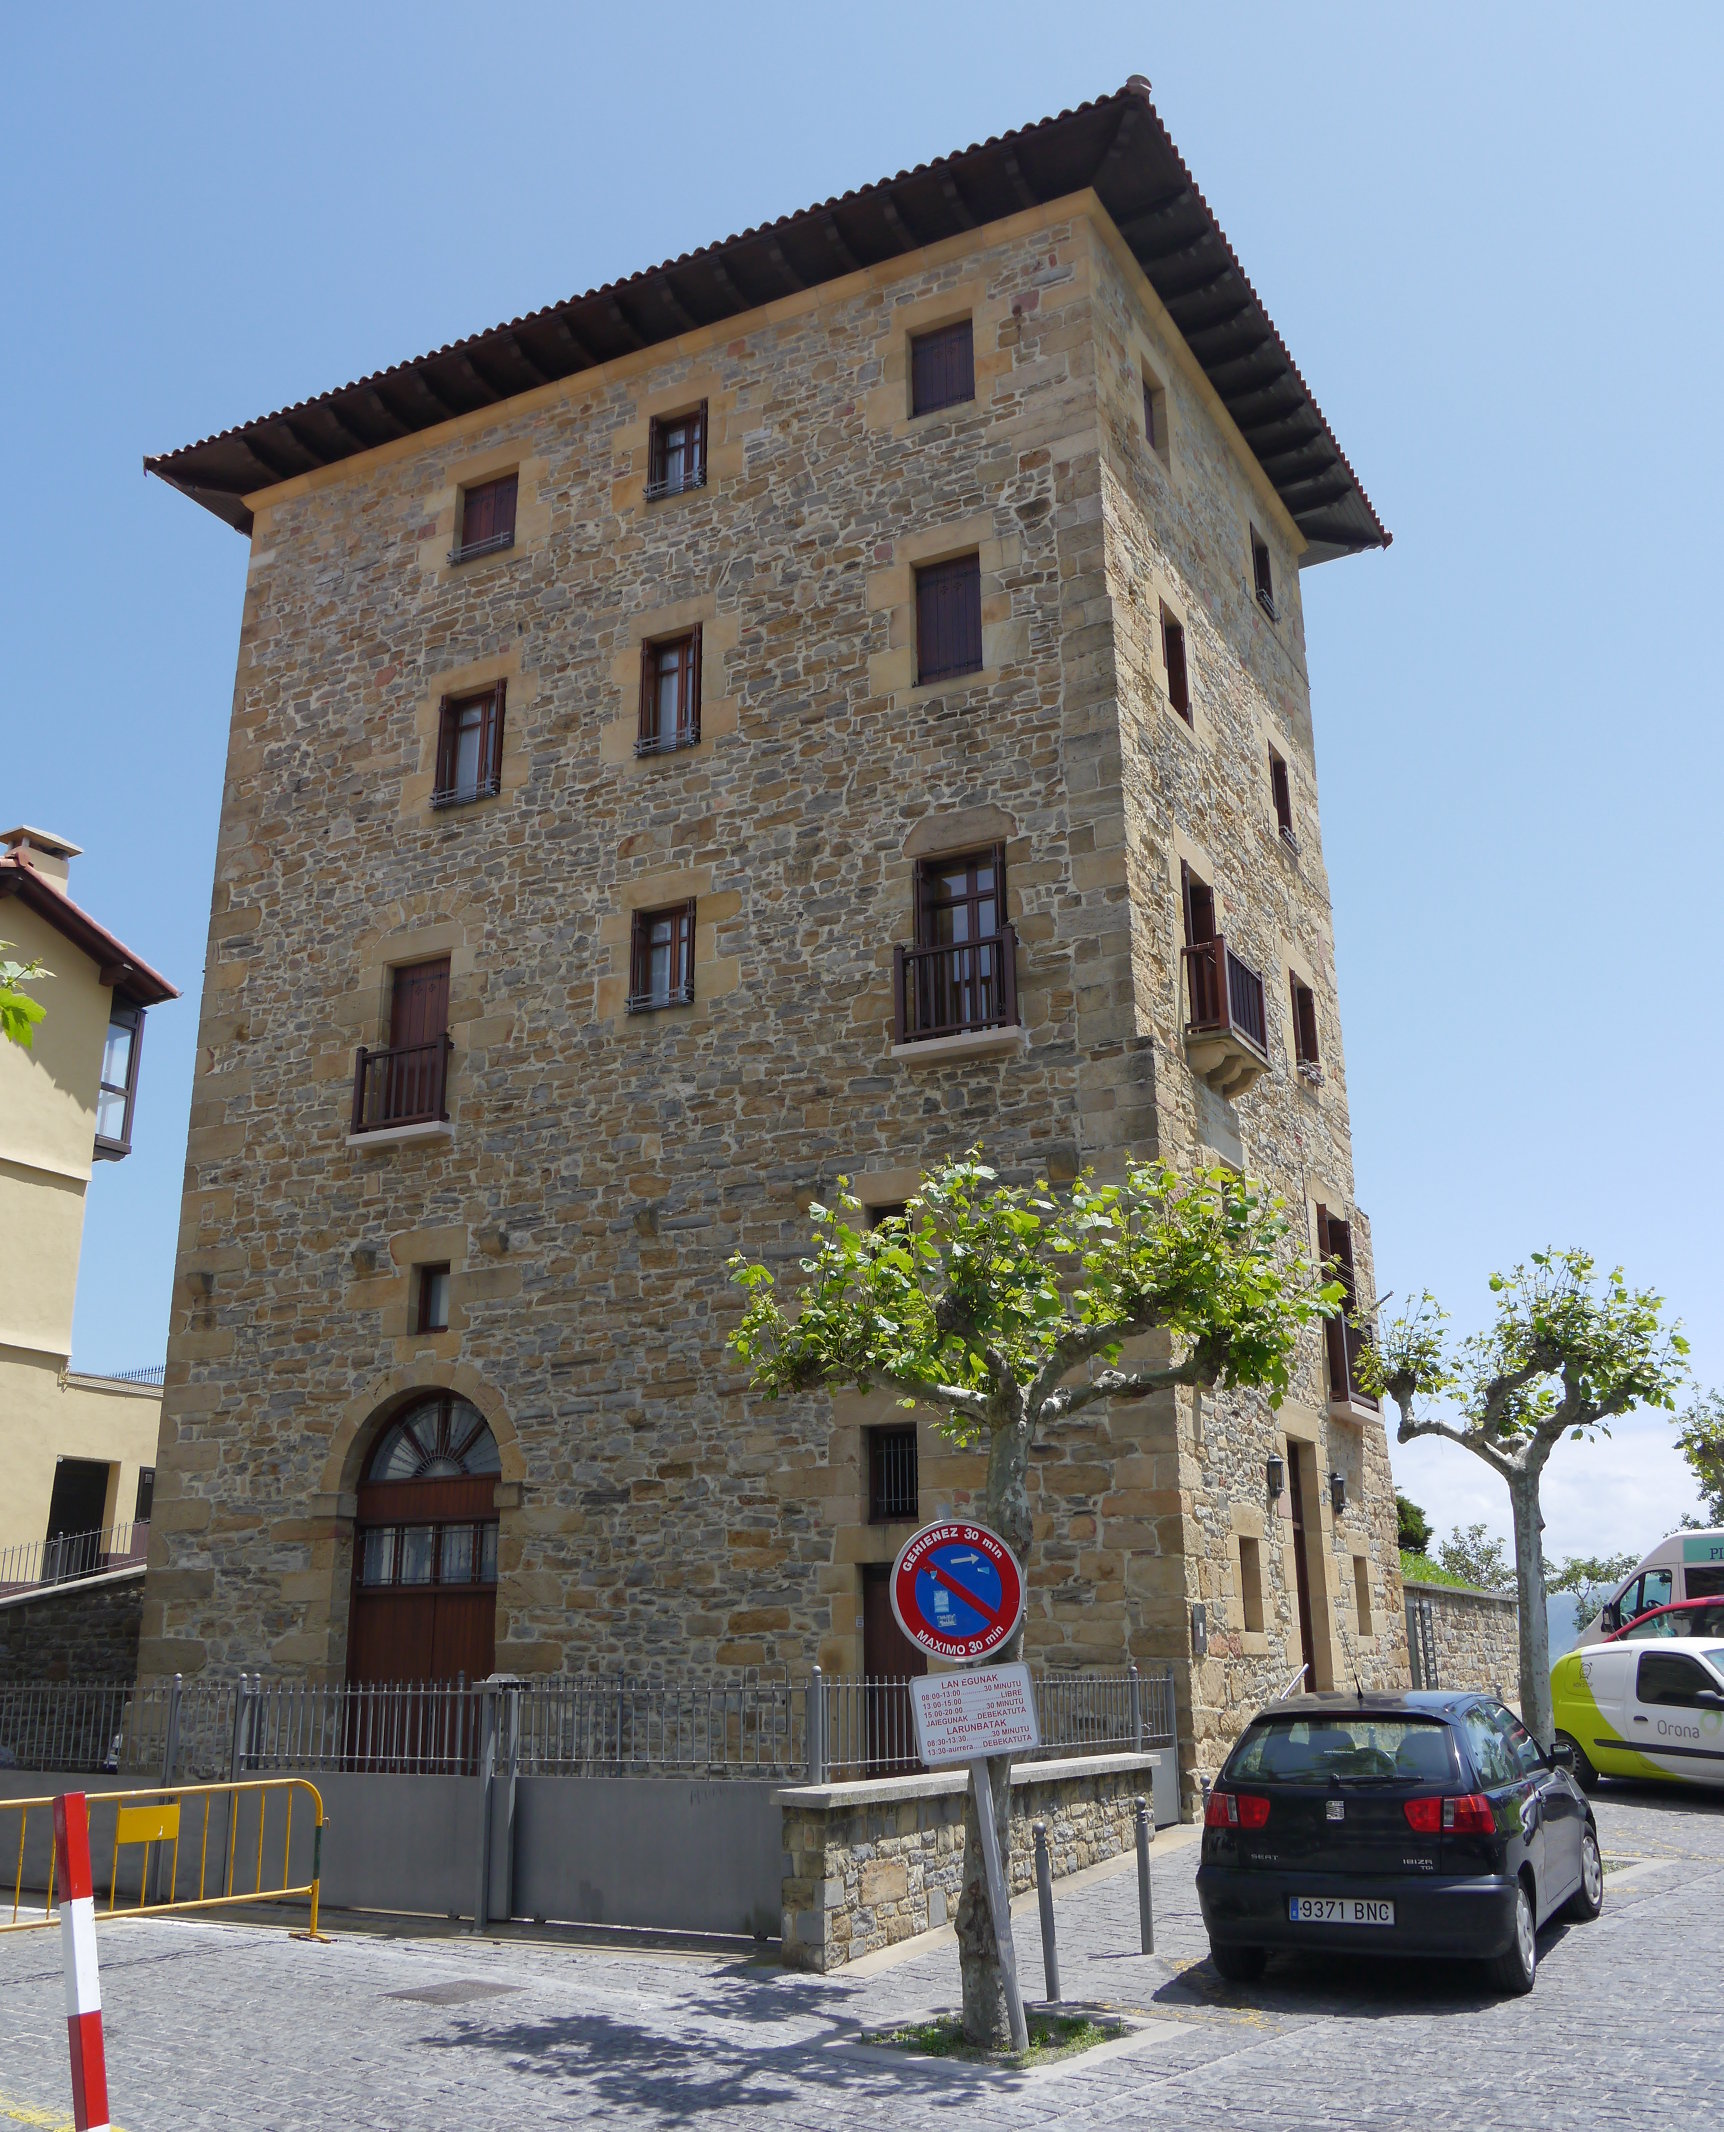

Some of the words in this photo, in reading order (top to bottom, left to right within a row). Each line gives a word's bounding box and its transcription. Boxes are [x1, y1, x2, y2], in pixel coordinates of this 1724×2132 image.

[902, 1528, 958, 1572] GEHIENEZ
[964, 1528, 979, 1540] 30
[982, 1538, 1003, 1558] min
[917, 1630, 965, 1654] MAXIMO
[969, 1642, 983, 1653] 30
[985, 1625, 1004, 1645] min
[942, 1680, 958, 1689] LAN
[962, 1674, 998, 1686] EGUNAK
[994, 1681, 1021, 1690] MINUTU
[1001, 1689, 1022, 1698] LIBRE
[997, 1698, 1024, 1708] MINUTU
[926, 1715, 968, 1727] JAIEGUNAK
[978, 1707, 1026, 1719] DEBEKATUTA
[947, 1719, 1006, 1735] LARUNBATAK
[1002, 1726, 1029, 1735] MINUTU
[1657, 1719, 1700, 1739] Orona
[983, 1735, 1032, 1747] DEBEKATUTA
[1302, 1901, 1344, 1919] 9371
[1355, 1902, 1389, 1921] BNC
